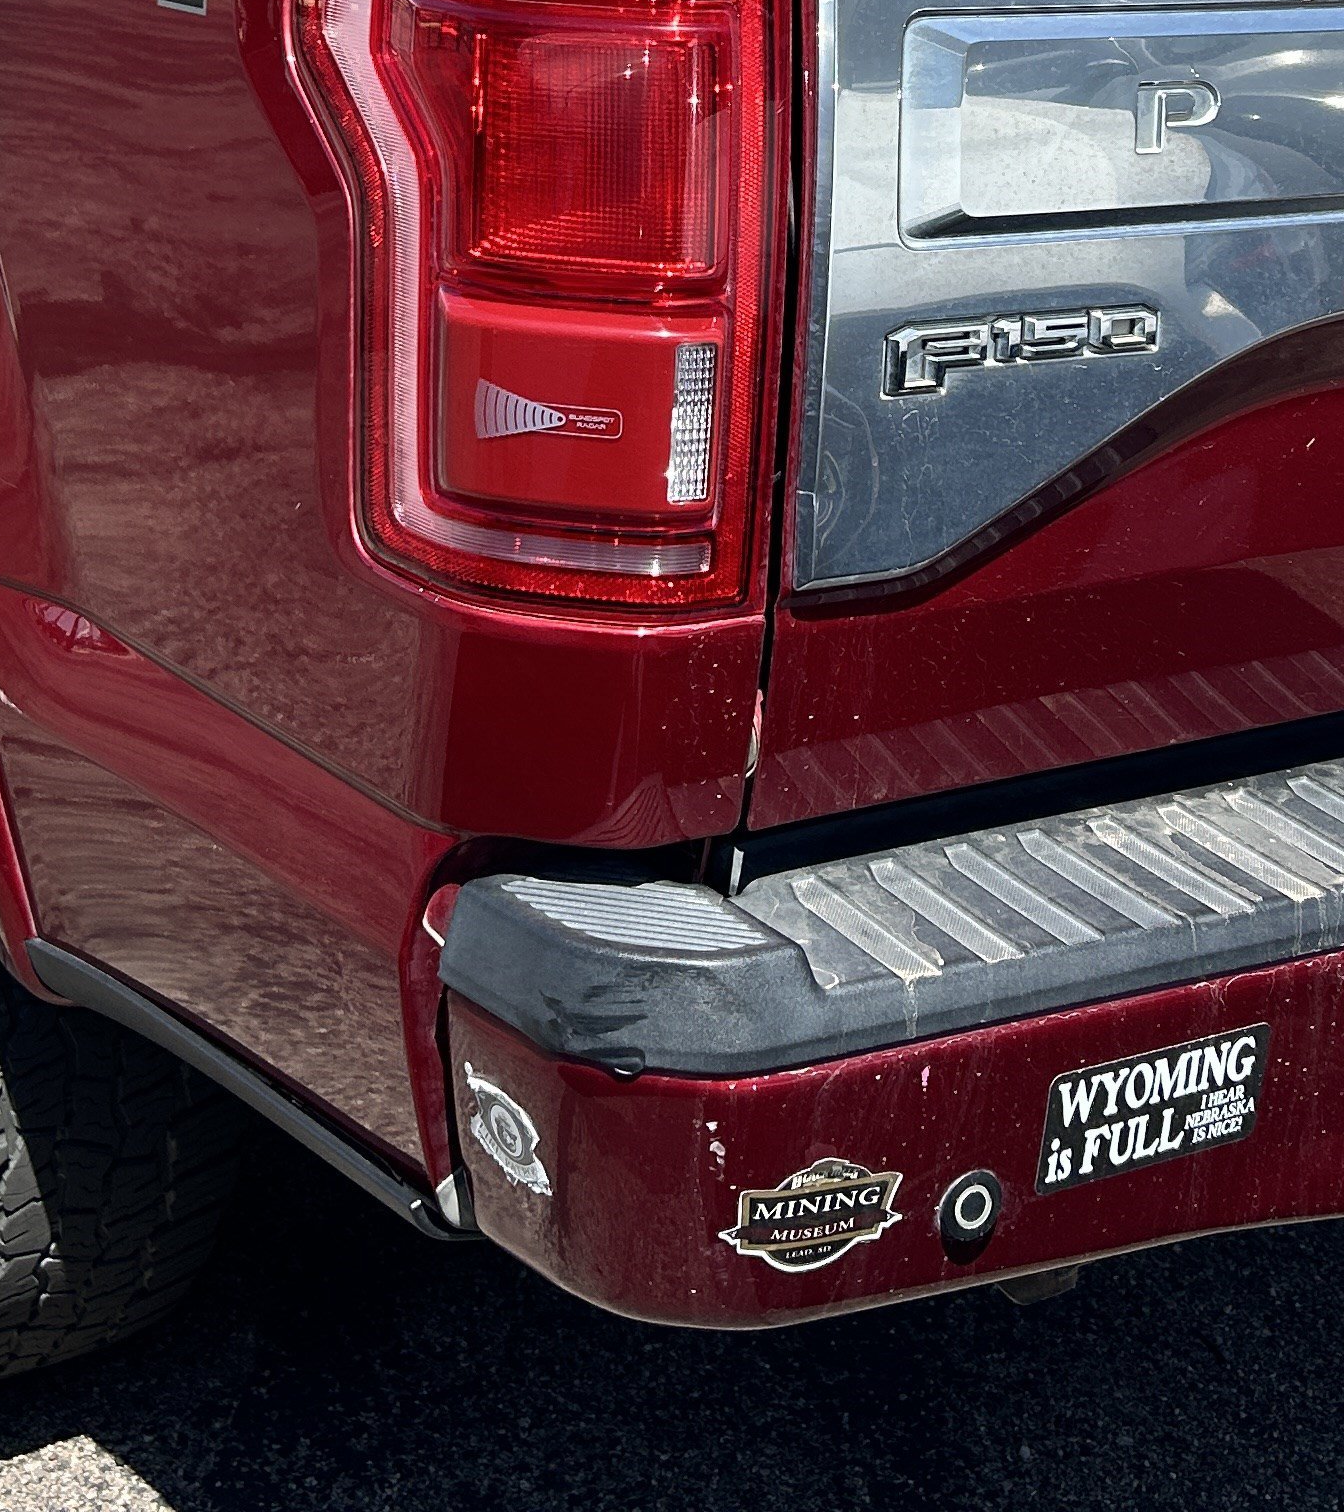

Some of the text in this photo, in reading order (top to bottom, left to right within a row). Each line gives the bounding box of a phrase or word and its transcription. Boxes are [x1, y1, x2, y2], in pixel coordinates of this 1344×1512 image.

[1058, 1035, 1256, 1128] WYOMING
[1200, 1084, 1245, 1110] I HEAR
[1184, 1096, 1256, 1130] NEBRASKA
[1078, 1108, 1185, 1175] FULL
[1191, 1127, 1207, 1145] IS
[752, 1186, 881, 1221] MINING
[770, 1217, 855, 1241] MUSEUM
